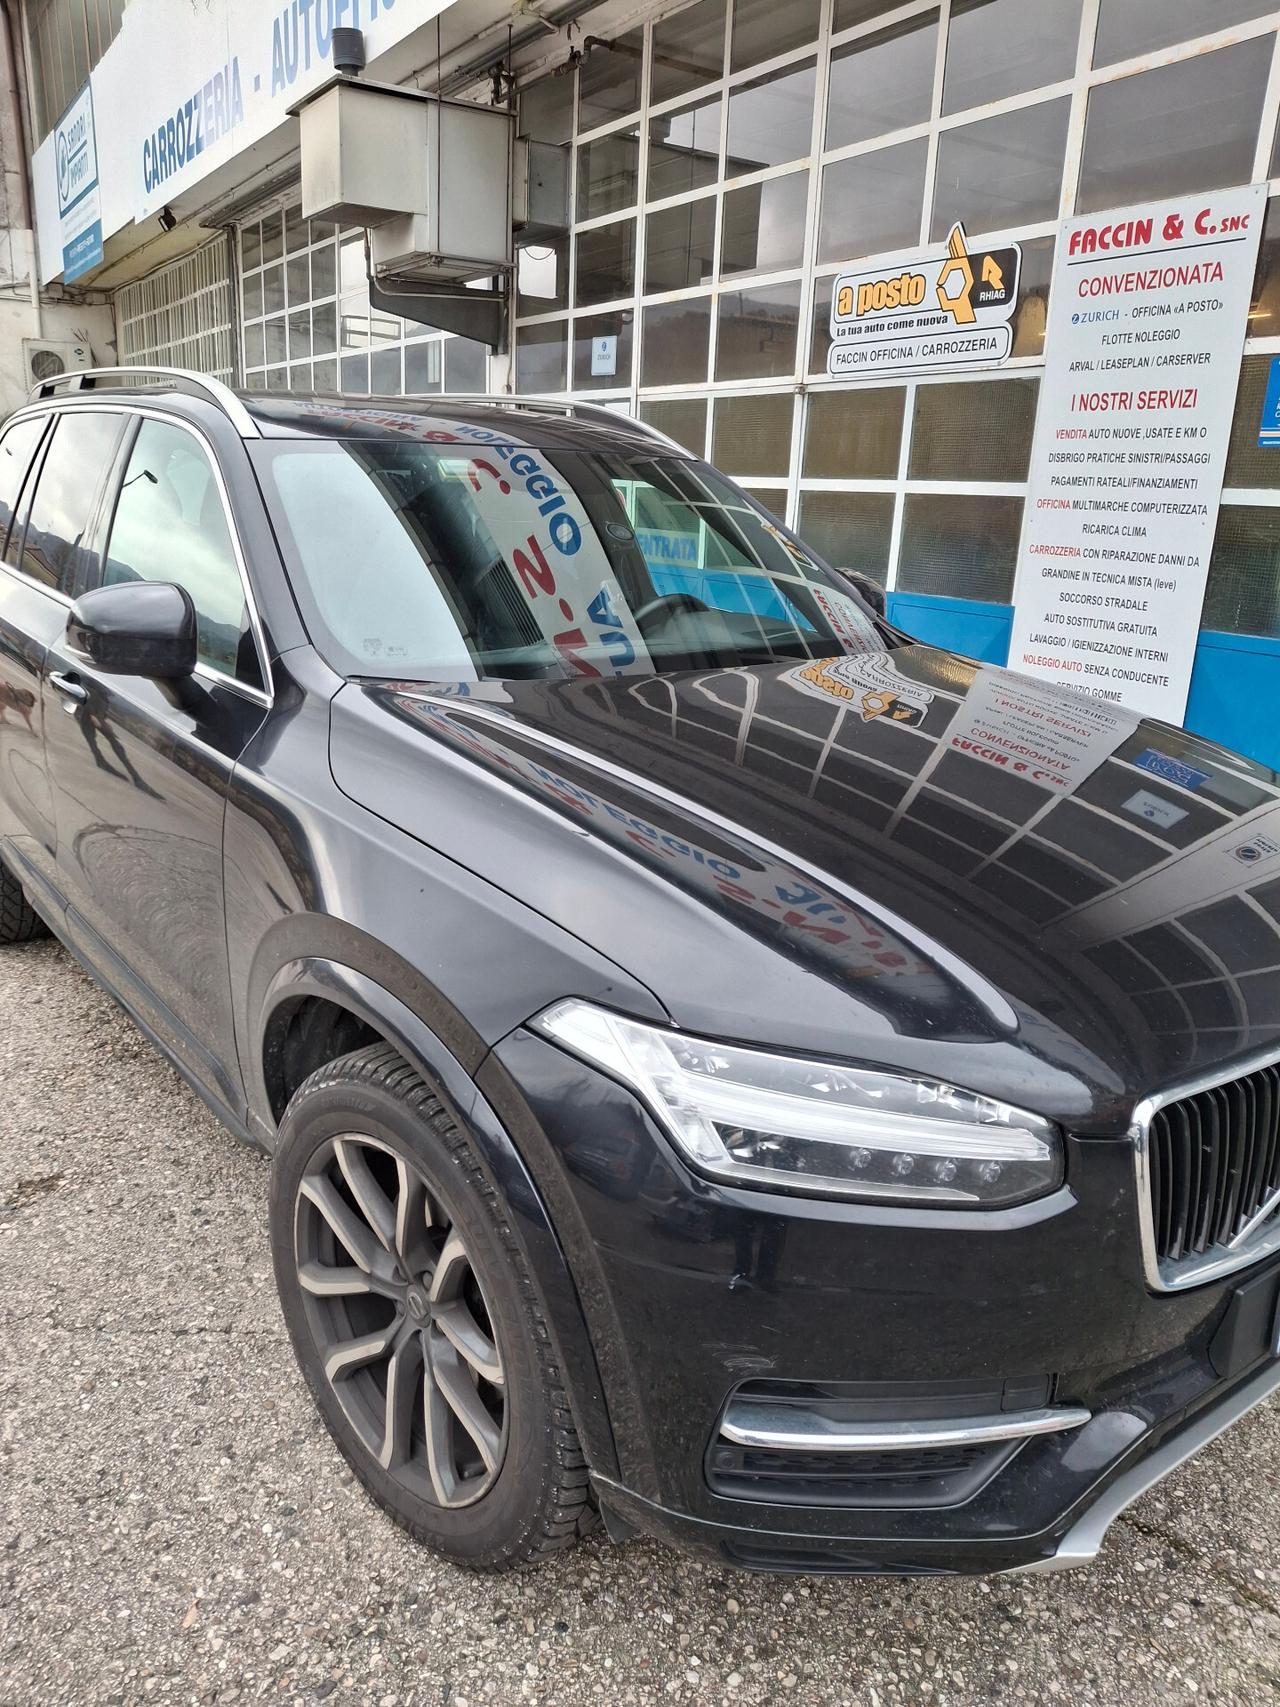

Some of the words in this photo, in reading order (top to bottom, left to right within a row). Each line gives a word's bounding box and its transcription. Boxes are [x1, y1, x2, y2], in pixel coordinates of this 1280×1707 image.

[143, 56, 244, 194] CARROZZERIA
[272, 0, 397, 98] AUTO
[1068, 218, 1153, 256] FACCIN
[1162, 213, 1185, 241] &
[1220, 214, 1250, 233] SNC
[1078, 261, 1224, 298] CONVENZIONATA
[838, 285, 854, 316] a
[855, 272, 927, 317] posto
[979, 289, 1006, 302] RHIAG
[1080, 309, 1120, 324] ZURICH
[1131, 303, 1172, 320] OFFICINA
[836, 326, 847, 337] La
[848, 324, 863, 336] tua
[864, 322, 886, 333] auto
[887, 320, 916, 331] come
[916, 316, 949, 327] nuova
[1101, 332, 1133, 346] FLOTTE
[1134, 328, 1181, 344] NOLEGGIO
[836, 351, 868, 366] FACCIN
[869, 346, 914, 362] OFFICINA
[915, 344, 921, 357] /
[922, 337, 998, 356] CARROZZERIA
[1069, 361, 1095, 373] ARVAL
[1096, 360, 1101, 371] /
[1101, 356, 1150, 371] LEASEPLAN
[1150, 356, 1155, 367] /
[1156, 352, 1212, 367] CARSERVER
[1071, 394, 1077, 412] I
[1078, 391, 1134, 411] NOSTRI
[1136, 388, 1199, 410] SERVIZI
[1055, 428, 1087, 440] VENDITA
[1088, 428, 1111, 439] AUTO
[1112, 427, 1141, 439] NUOVE
[1175, 427, 1182, 438] E
[1183, 427, 1199, 438] KM
[1048, 452, 1085, 463] DISBRIGO
[1086, 452, 1126, 463] PRATICHE
[1127, 453, 1211, 464] SINISTRI/PASSAGGI
[1050, 476, 1095, 487] PAGAMENTI
[1096, 476, 1198, 490] RATEALI/FINANZIAMENTI
[1036, 498, 1071, 510] OFFICINA
[1072, 500, 1130, 512] MULTIMARCHE
[1130, 502, 1208, 516] COMPUTERIZZATA
[1082, 523, 1120, 536] RICARICA
[1121, 526, 1147, 538] CLIMA
[1029, 544, 1081, 558] CARROZZERIA
[1082, 548, 1100, 559] CON
[1101, 549, 1157, 565] RIPARAZIONE
[1158, 554, 1186, 567] DANNI
[1187, 556, 1200, 568] DA
[1041, 567, 1080, 581] GRANDINE
[1081, 571, 1091, 582] IN
[1091, 572, 1126, 585] TECNICA
[1127, 575, 1153, 588] MISTA
[1153, 577, 1177, 592] (leve)
[1059, 592, 1103, 606] SOCCORSO
[1104, 597, 1149, 612] STRADALE
[1043, 612, 1065, 625] AUTO
[1066, 615, 1116, 632] SOSTITUTIVA
[1117, 622, 1158, 637] GRATUITA
[1029, 633, 1067, 647] LAVAGGIO
[1071, 638, 1133, 657] IGIENIZZAZIONE
[1134, 647, 1169, 663] INTERNI
[1022, 654, 1061, 669] NOLEGGIO
[1061, 659, 1083, 672] AUTO
[1084, 663, 1110, 677] SENZA
[1111, 668, 1170, 687] CONDUCENTE
[1091, 688, 1123, 703] GOMME
